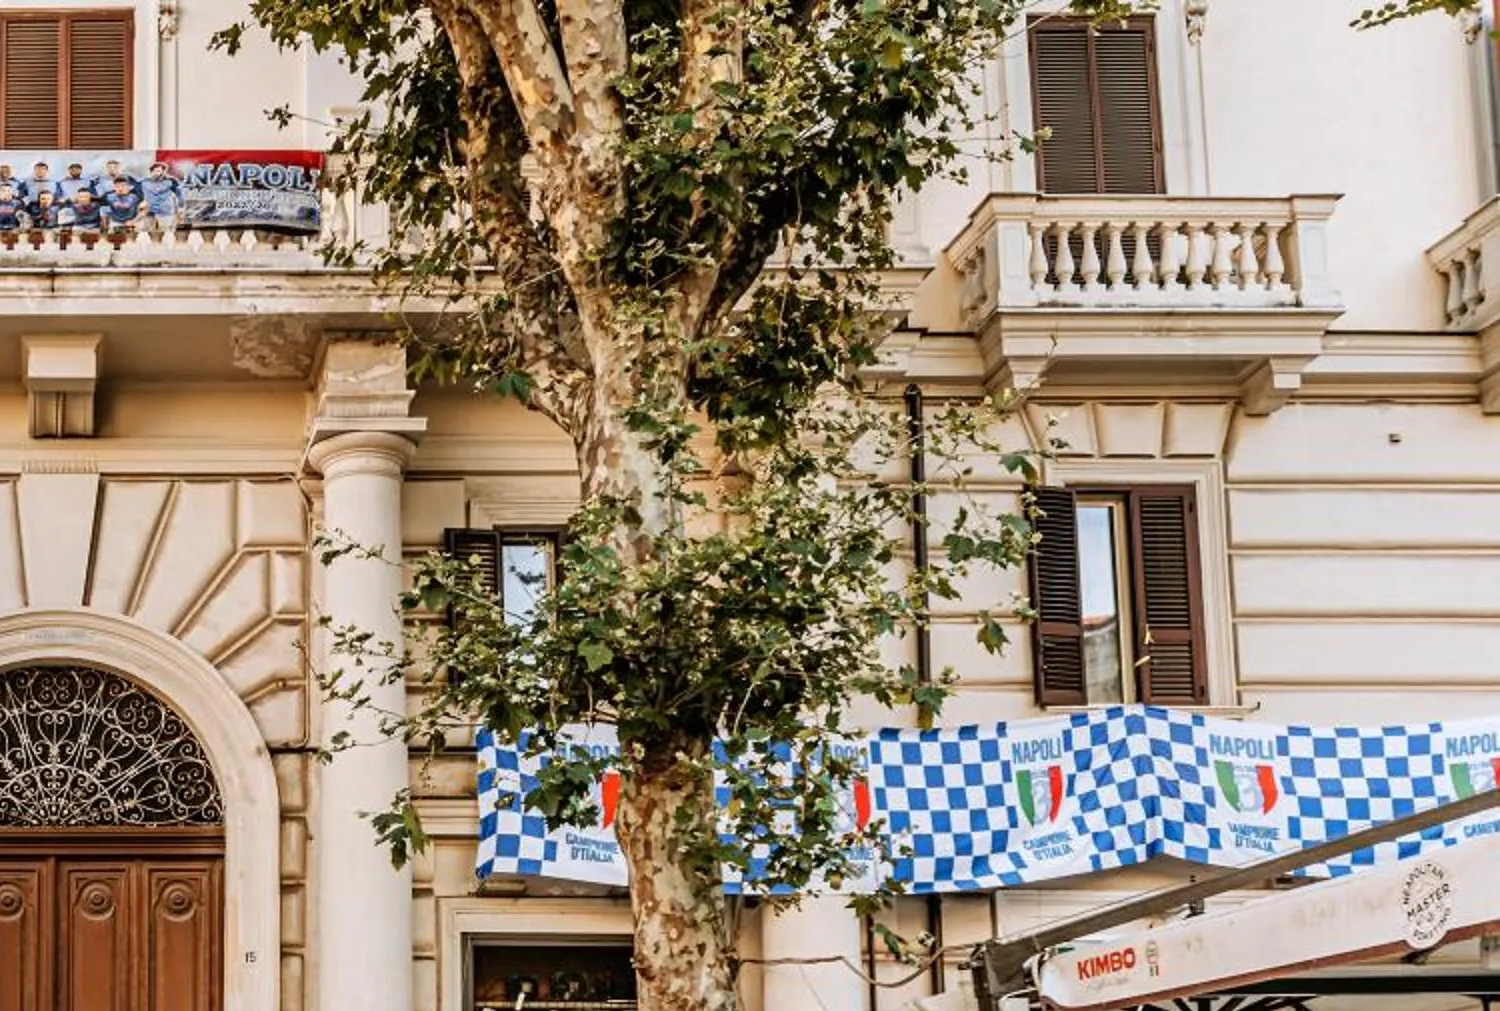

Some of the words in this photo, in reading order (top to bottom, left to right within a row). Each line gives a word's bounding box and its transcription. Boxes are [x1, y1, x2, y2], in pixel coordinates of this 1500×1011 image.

[183, 163, 321, 191] NAPOLI
[1011, 738, 1062, 764] NAPOLI
[1208, 733, 1274, 761] NAPOLI
[1445, 732, 1500, 759] NAPOL
[1407, 883, 1450, 919] MASTER
[245, 951, 257, 963] 15
[1077, 947, 1136, 981] KIMBO
